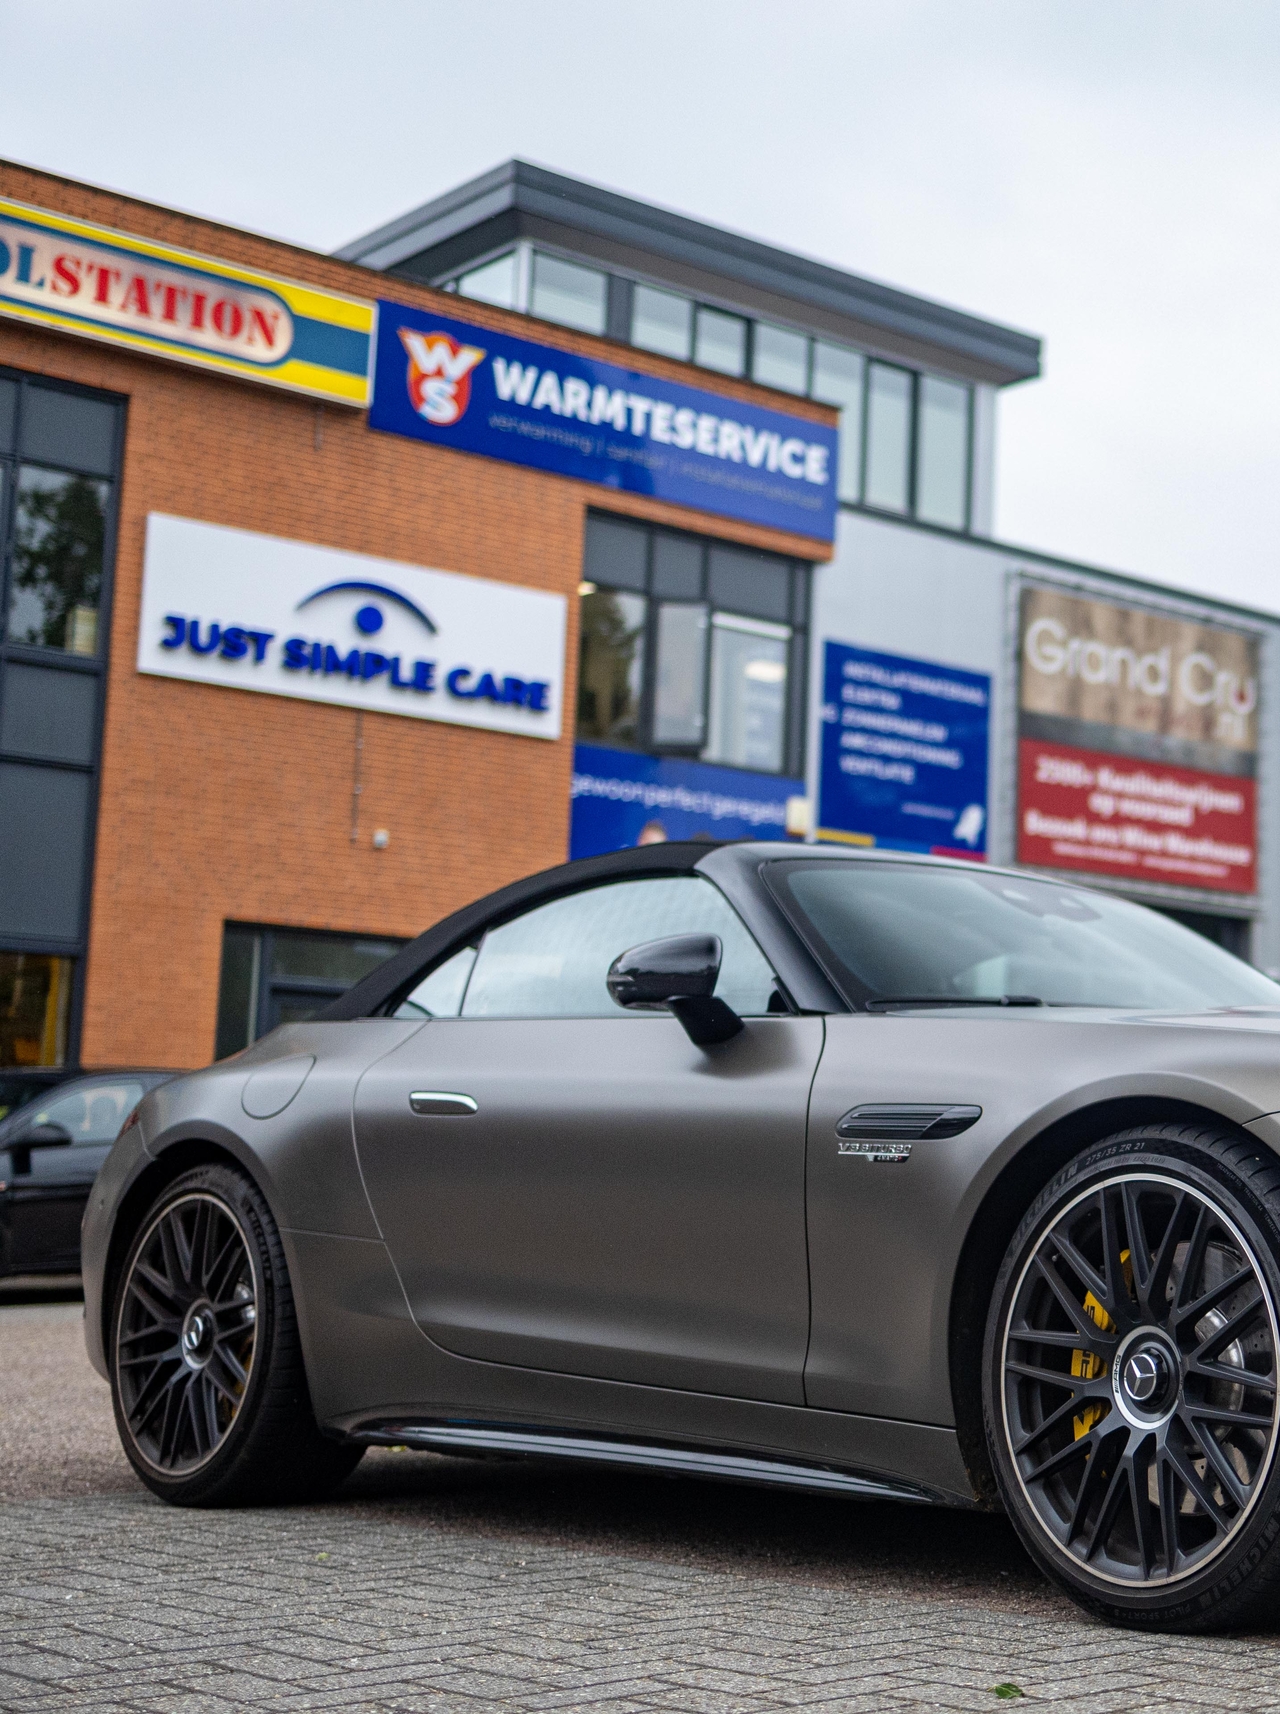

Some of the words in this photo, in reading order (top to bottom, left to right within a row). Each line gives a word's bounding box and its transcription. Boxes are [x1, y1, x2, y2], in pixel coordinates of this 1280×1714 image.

[492, 356, 830, 485] WARMTESERVICE
[161, 613, 274, 663] JUST
[283, 637, 436, 692] SIMPLE
[446, 668, 550, 713] CARE
[1025, 617, 1172, 697] Grand
[1180, 652, 1257, 715] Cru
[1088, 791, 1116, 819] op
[1118, 797, 1195, 827] voorraad
